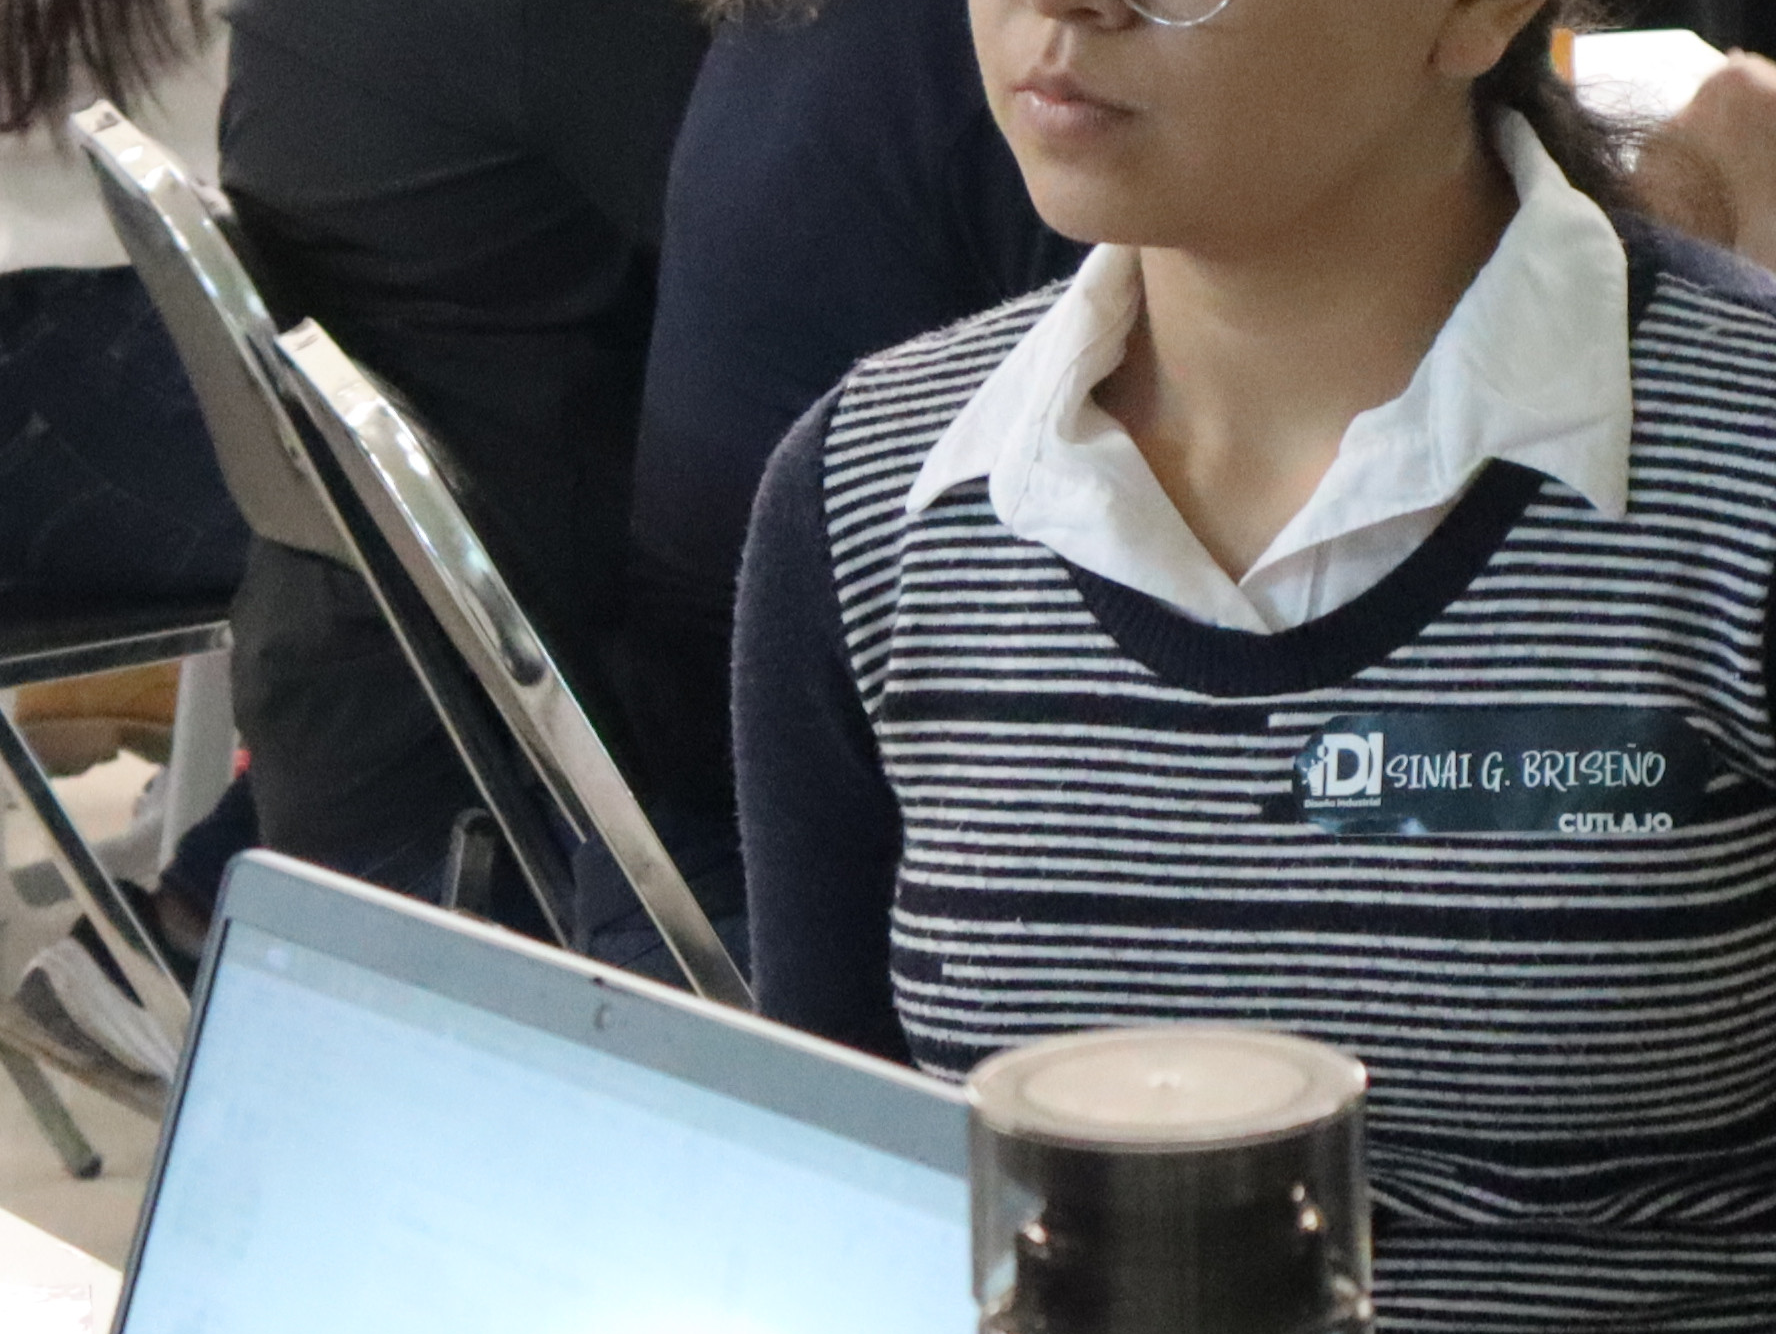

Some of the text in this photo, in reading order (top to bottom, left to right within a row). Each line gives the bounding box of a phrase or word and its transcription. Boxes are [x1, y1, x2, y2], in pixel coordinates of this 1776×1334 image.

[1386, 743, 1666, 792] SINAI G. BRISEÑO
[1558, 812, 1673, 833] CUTLAJO
